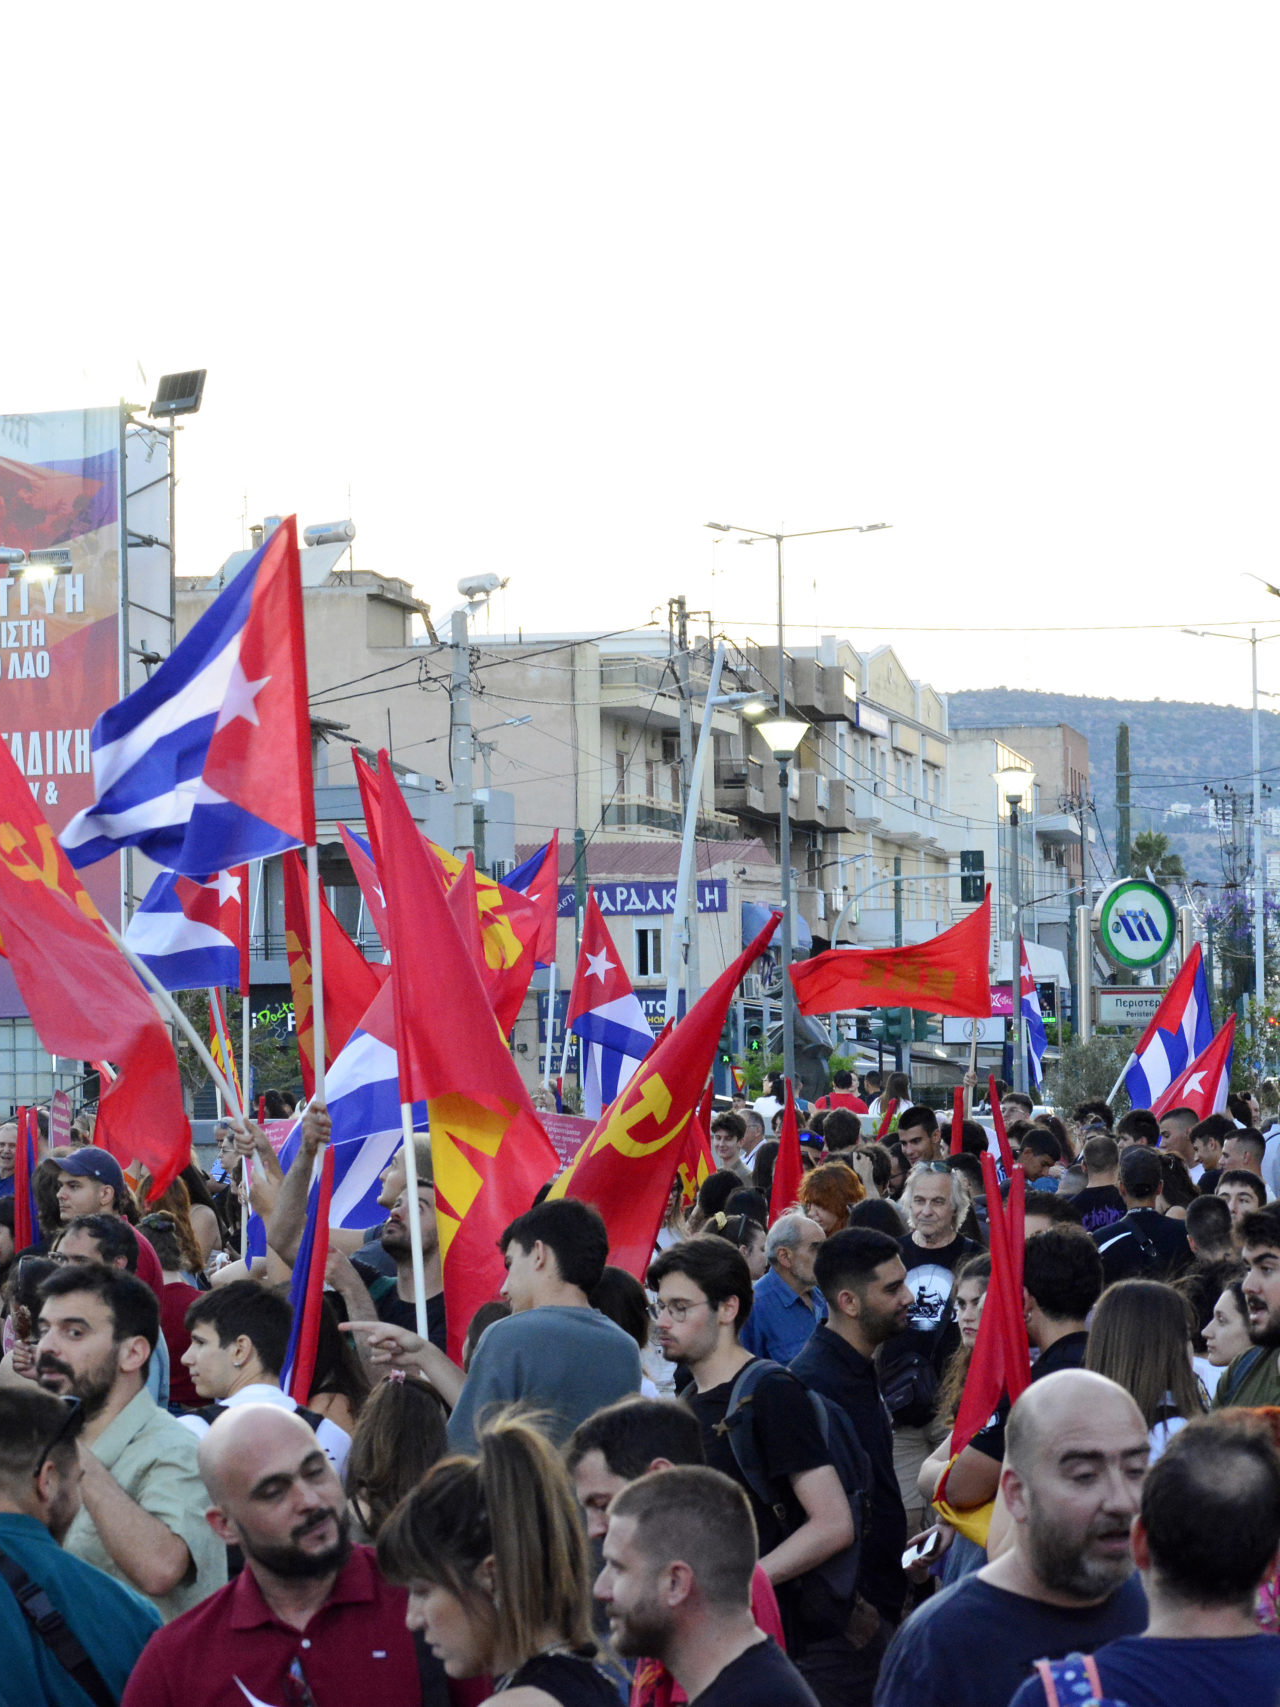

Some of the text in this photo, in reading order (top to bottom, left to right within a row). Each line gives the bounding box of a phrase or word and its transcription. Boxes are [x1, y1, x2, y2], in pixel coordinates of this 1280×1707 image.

[7, 650, 50, 680] ΛΑΟ
[45, 781, 58, 805] &
[257, 1002, 295, 1025] Docto
[1115, 998, 1161, 1009] Περιστέρ
